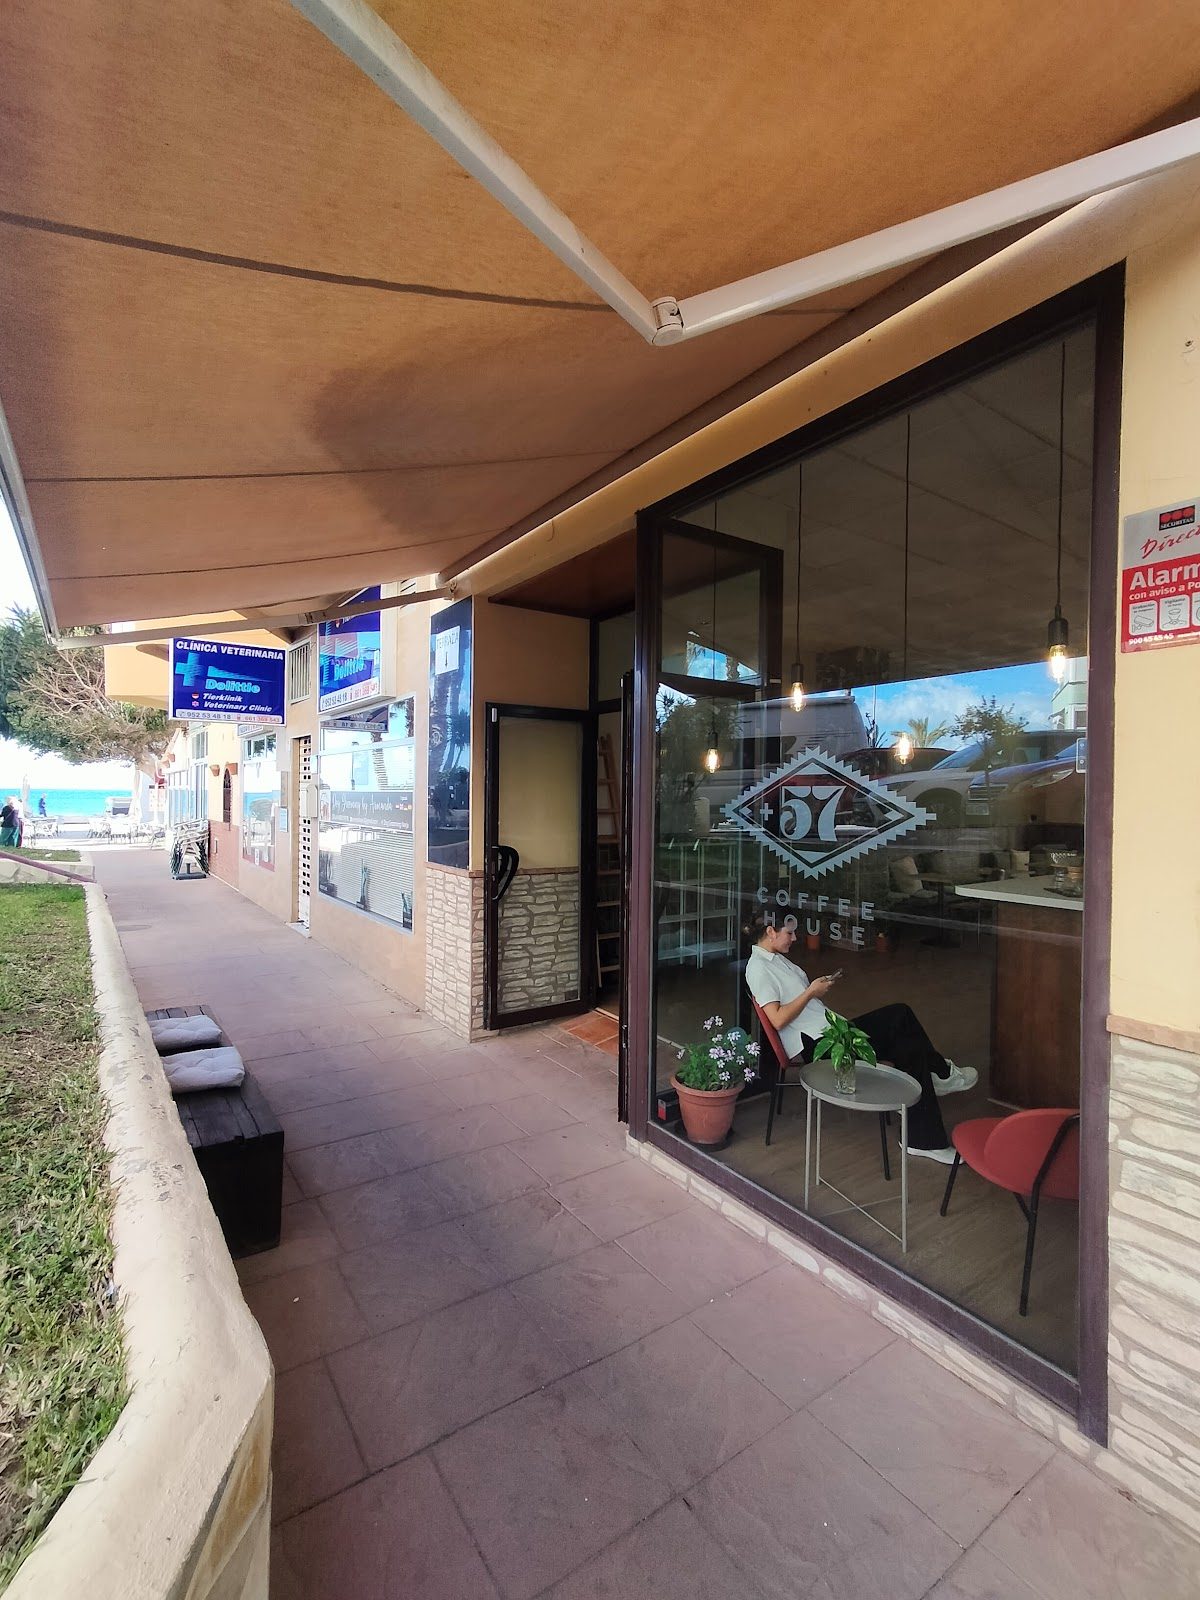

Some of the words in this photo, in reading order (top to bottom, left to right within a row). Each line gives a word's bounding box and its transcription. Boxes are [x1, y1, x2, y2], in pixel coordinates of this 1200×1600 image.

[1160, 518, 1194, 530] SECURITAS
[1129, 590, 1147, 600] con
[1149, 585, 1176, 597] aviso
[1178, 584, 1185, 592] a
[1128, 637, 1143, 645] 900
[176, 640, 218, 653] CLÍNICA
[220, 646, 284, 660] VETERINARIA
[205, 678, 261, 693] Dolittle
[202, 693, 243, 702] Tierklinik
[204, 701, 248, 712] Veterinary
[248, 704, 273, 712] Clinic
[756, 886, 875, 921] COFFEE
[763, 910, 865, 946] HOUSE
